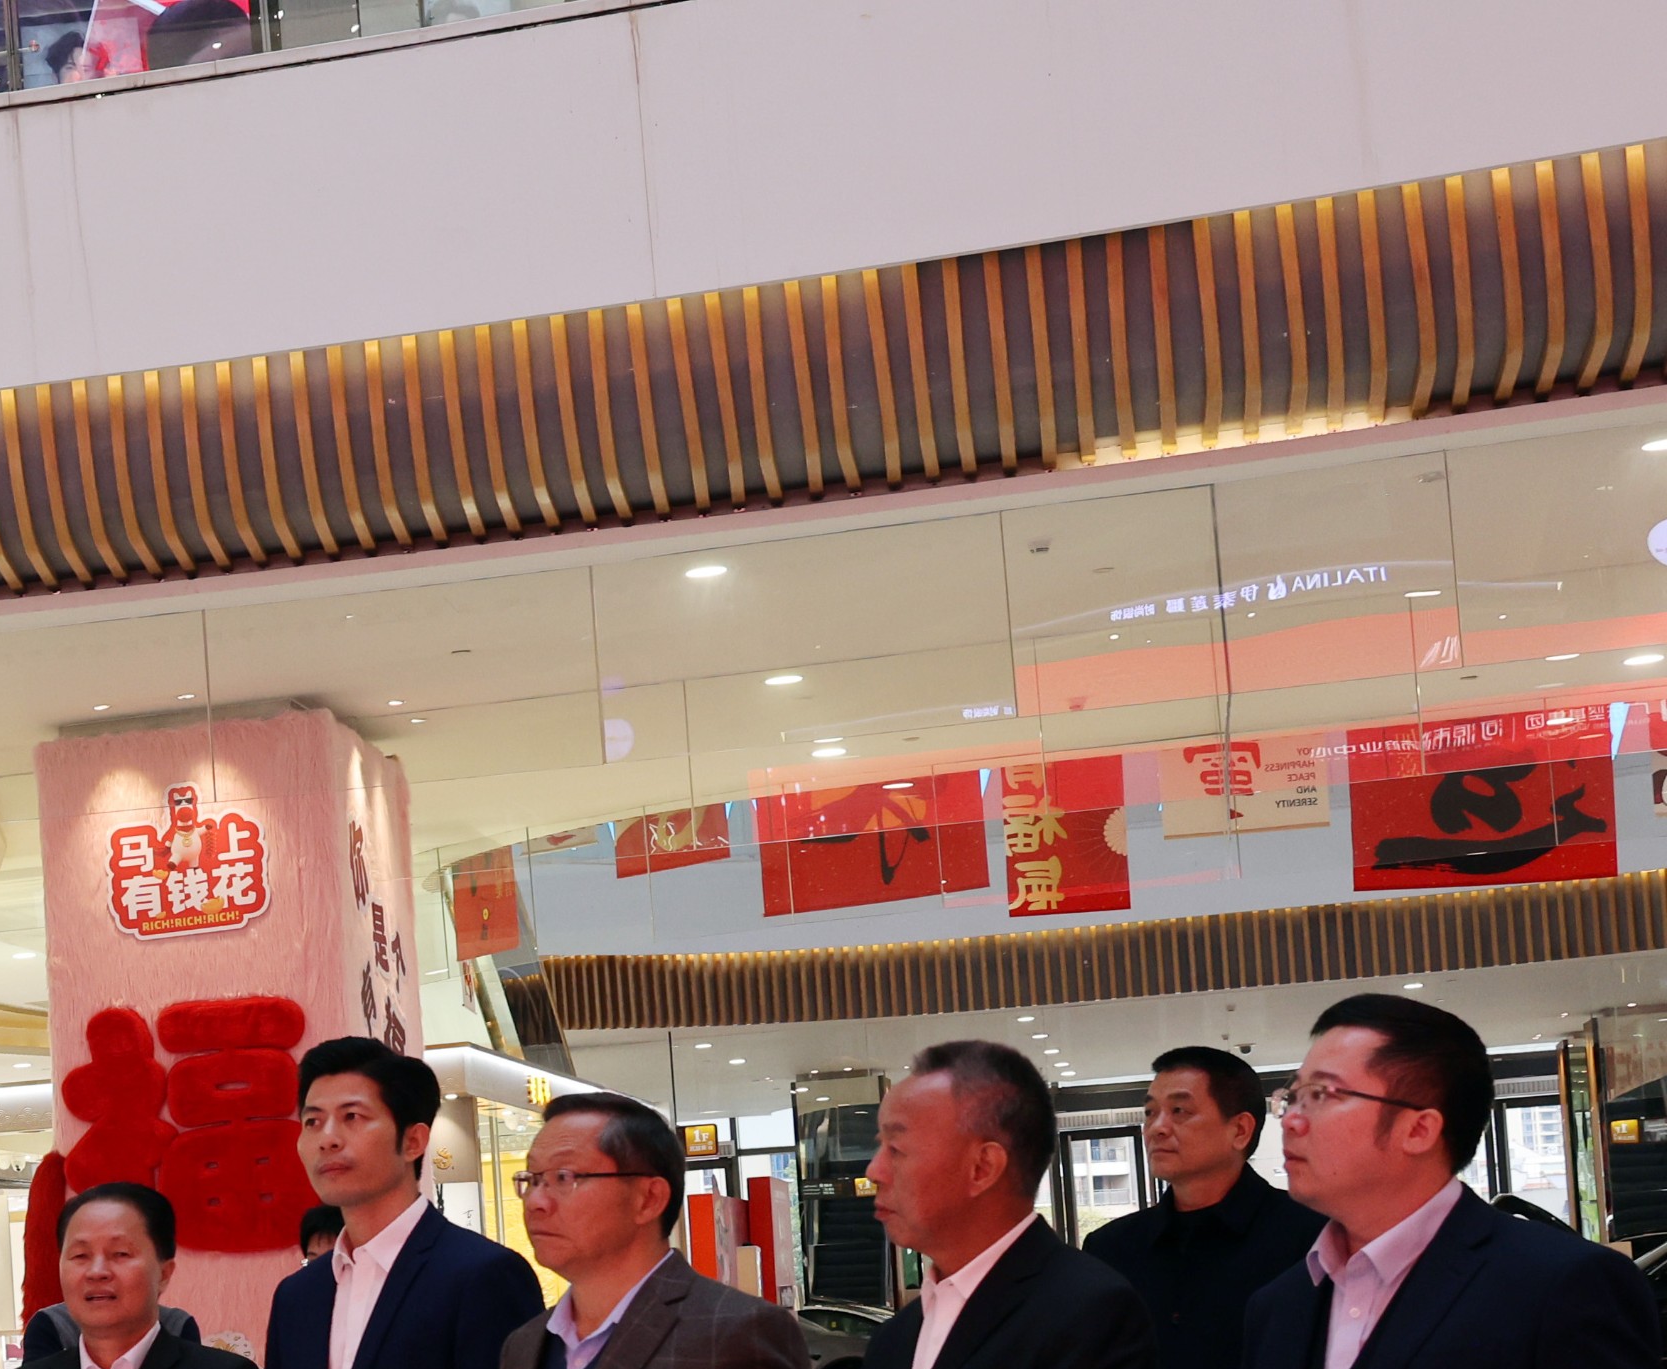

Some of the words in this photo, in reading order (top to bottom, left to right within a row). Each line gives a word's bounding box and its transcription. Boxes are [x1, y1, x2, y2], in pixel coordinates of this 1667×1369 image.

[118, 834, 155, 872] 马
[217, 822, 255, 861] 上
[120, 862, 257, 920] 有钱花
